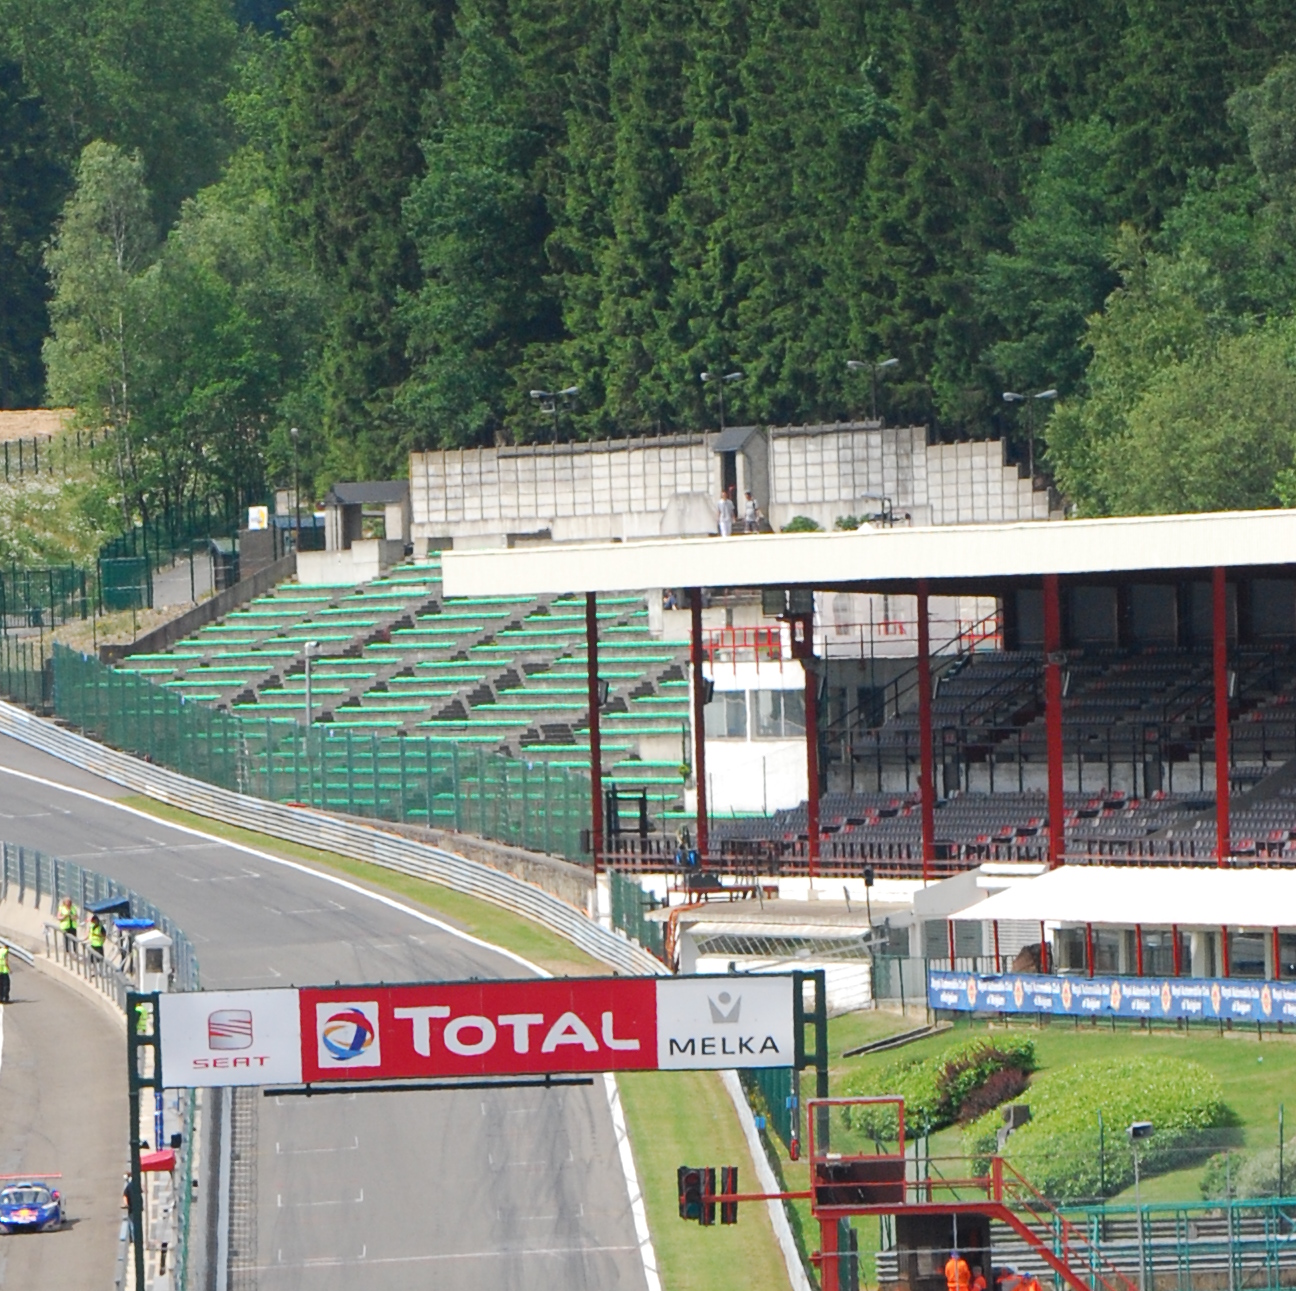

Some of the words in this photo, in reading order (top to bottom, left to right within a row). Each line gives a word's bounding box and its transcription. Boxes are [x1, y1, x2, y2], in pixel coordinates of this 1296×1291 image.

[394, 1006, 641, 1057] TOTAL
[669, 1036, 780, 1056] MELKA
[193, 1056, 271, 1069] SEAT
